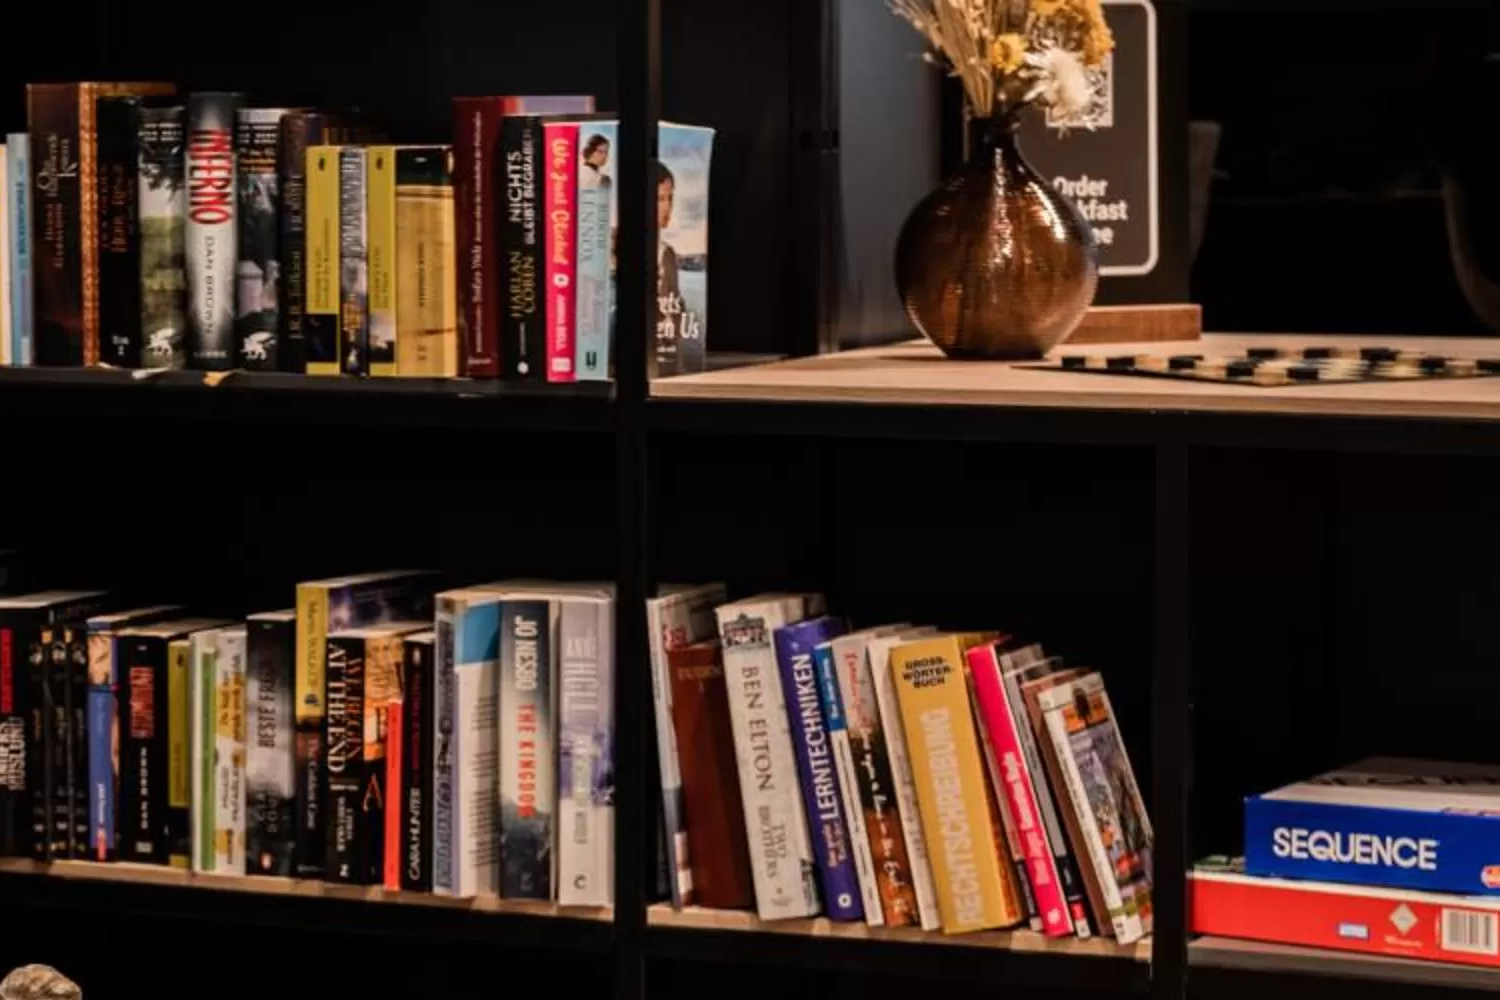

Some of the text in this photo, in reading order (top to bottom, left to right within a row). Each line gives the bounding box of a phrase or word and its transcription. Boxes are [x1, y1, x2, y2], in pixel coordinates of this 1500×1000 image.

[188, 129, 233, 226] INFERNO
[508, 151, 523, 223] NICHTS
[550, 137, 571, 266] We Just Clicked
[1053, 175, 1108, 197] Order
[523, 201, 535, 245] BLEIBT
[1077, 198, 1128, 220] kfast
[203, 236, 215, 336] DAN BROWN
[508, 251, 522, 318] HARLAN
[523, 256, 535, 313] COBEN
[680, 311, 699, 339] Us
[514, 615, 538, 637] JO
[902, 665, 955, 681] WÖRTER-
[904, 656, 948, 670] GROSS-
[912, 677, 946, 689] BUCH
[258, 708, 275, 749] BESTE
[328, 643, 347, 772] AT THE END
[347, 657, 363, 758] WE BEGIN
[742, 665, 775, 792] BEN ELTON
[792, 653, 841, 820] LERNTECHNIKEN
[140, 747, 148, 796] BROWN
[517, 704, 536, 818] THE KINGDOM
[409, 787, 421, 881] CARA HUNTER
[758, 805, 778, 879] BROTHERS
[771, 824, 787, 859] TWO
[920, 706, 985, 925] RECHTSCHREIBUNG
[1273, 827, 1440, 871] SEQUENCE
